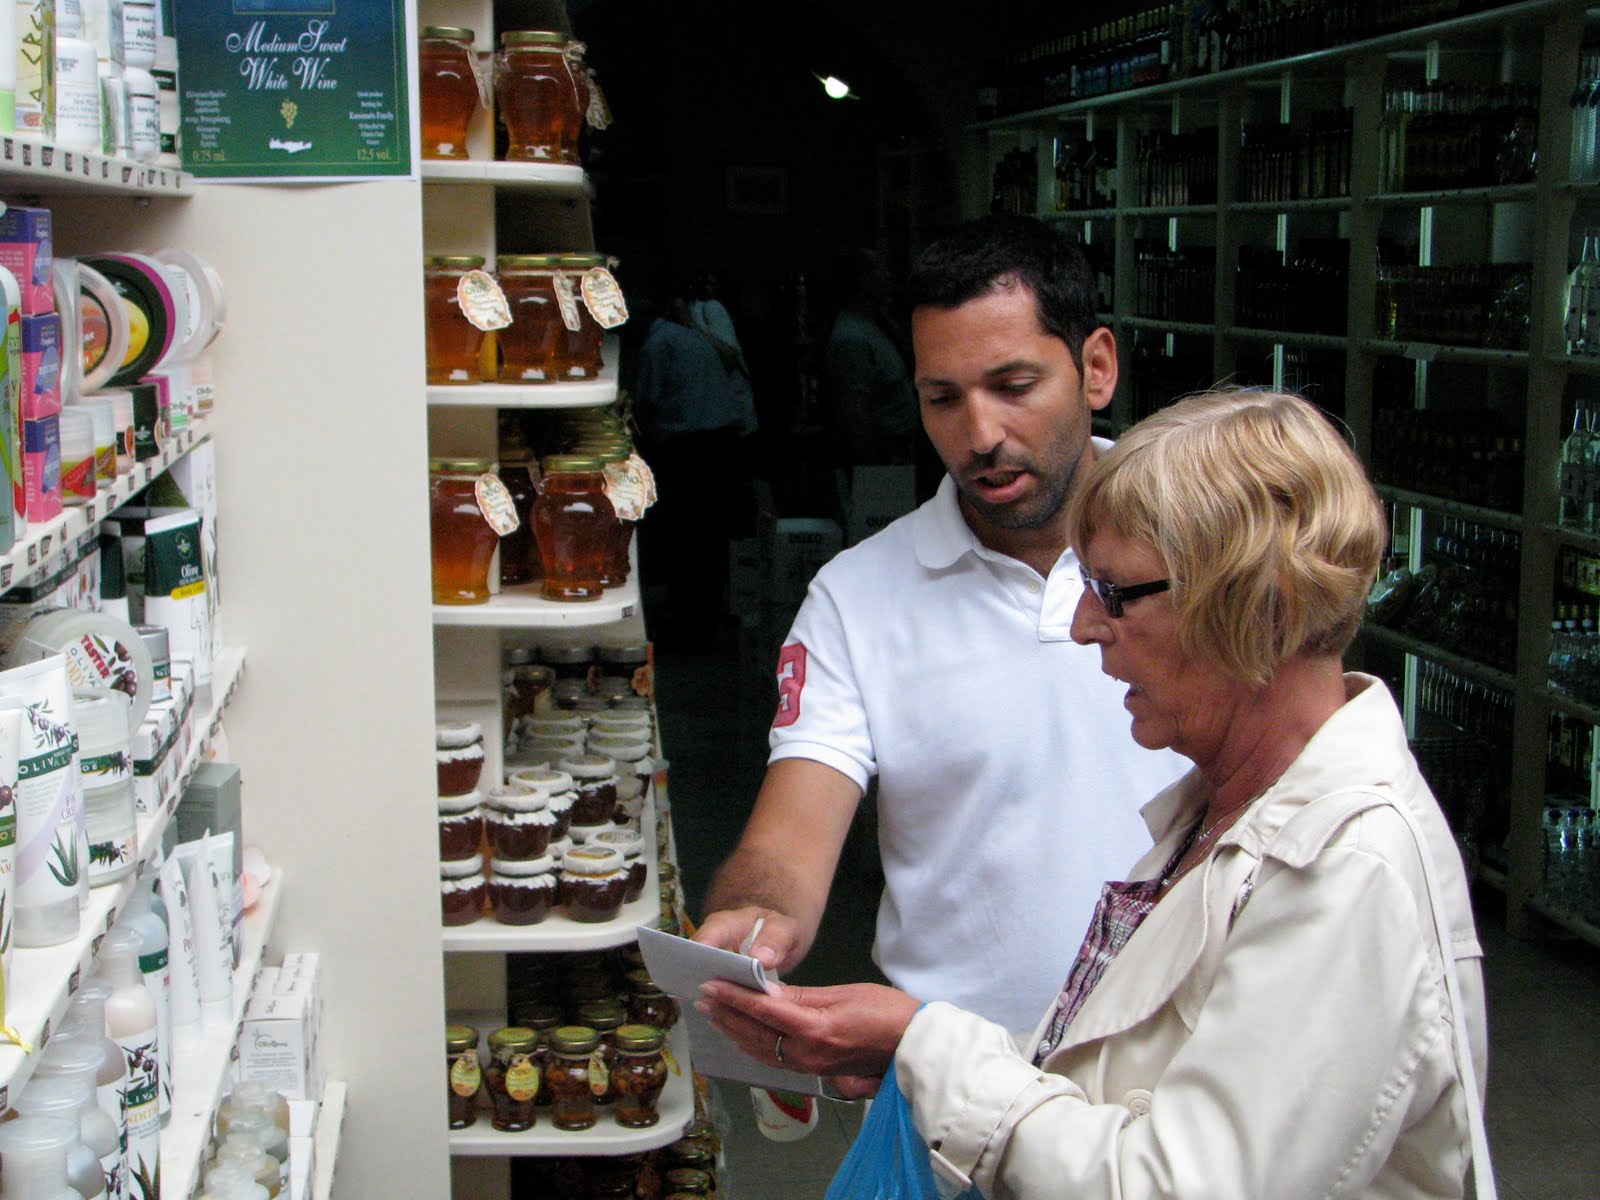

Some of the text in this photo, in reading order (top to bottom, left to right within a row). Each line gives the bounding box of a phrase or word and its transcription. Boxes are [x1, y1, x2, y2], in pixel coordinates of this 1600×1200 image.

[226, 19, 347, 53] Medium Sweet
[240, 56, 337, 90] White Wine
[181, 563, 199, 578] Olive
[81, 634, 110, 679] TESTER
